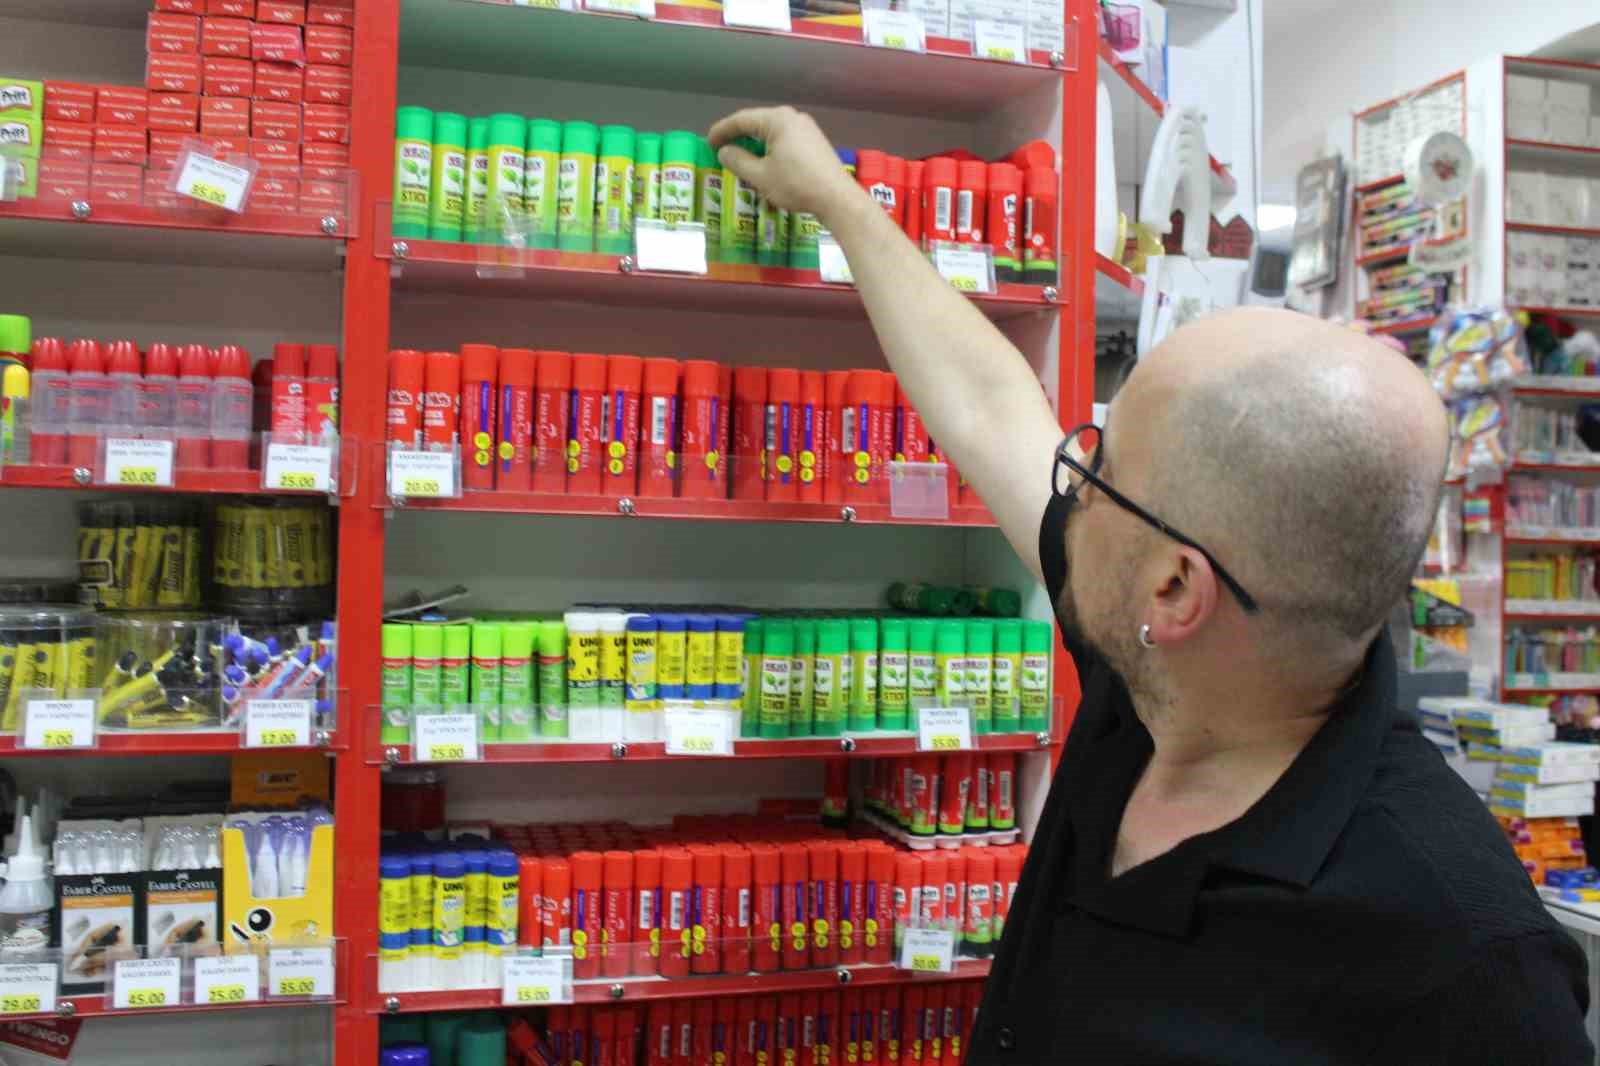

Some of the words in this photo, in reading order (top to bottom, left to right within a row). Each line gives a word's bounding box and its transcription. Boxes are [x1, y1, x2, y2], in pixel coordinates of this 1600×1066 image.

[120, 471, 157, 482] 20.00
[280, 476, 315, 488] 25.00
[63, 884, 132, 896] FABER-CASTELL
[149, 880, 215, 891] FABER-CASTELL
[280, 981, 315, 993] 35.00
[129, 993, 165, 1005] 45.00
[518, 990, 549, 1002] 15.00
